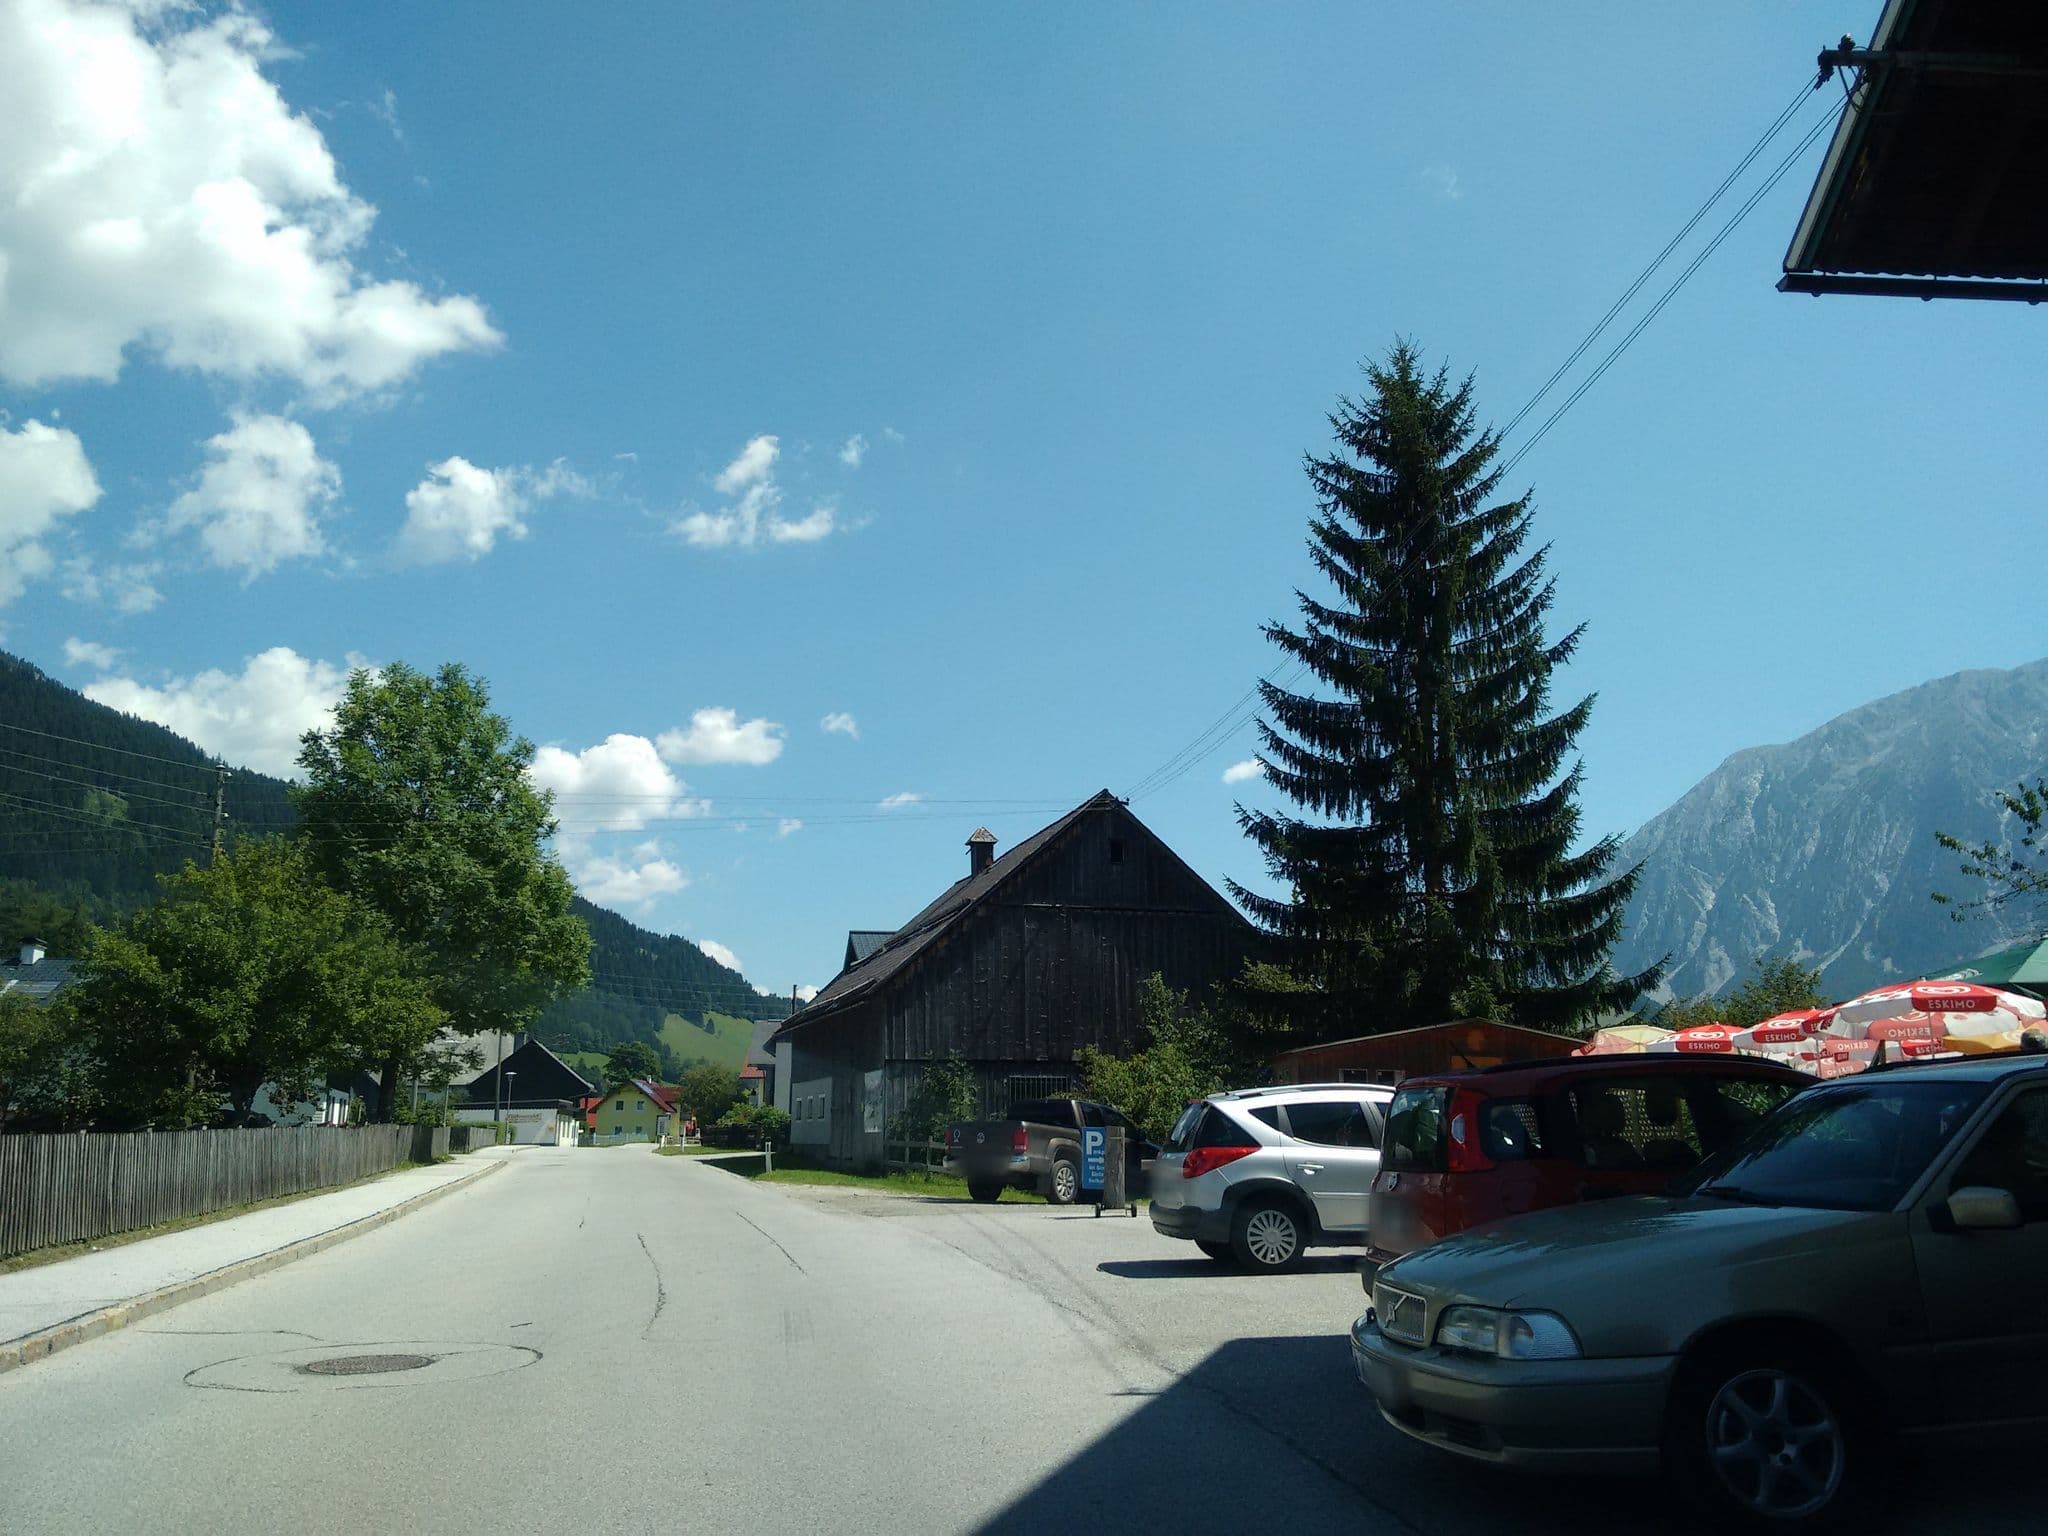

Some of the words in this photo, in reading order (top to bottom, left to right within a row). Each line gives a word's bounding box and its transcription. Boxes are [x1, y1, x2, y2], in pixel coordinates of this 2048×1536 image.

[1927, 999, 1976, 1009] ESKIMO
[1765, 1033, 1797, 1042] ESKIMO
[1688, 1042, 1720, 1050] ESKIMO
[1086, 1131, 1103, 1155] P
